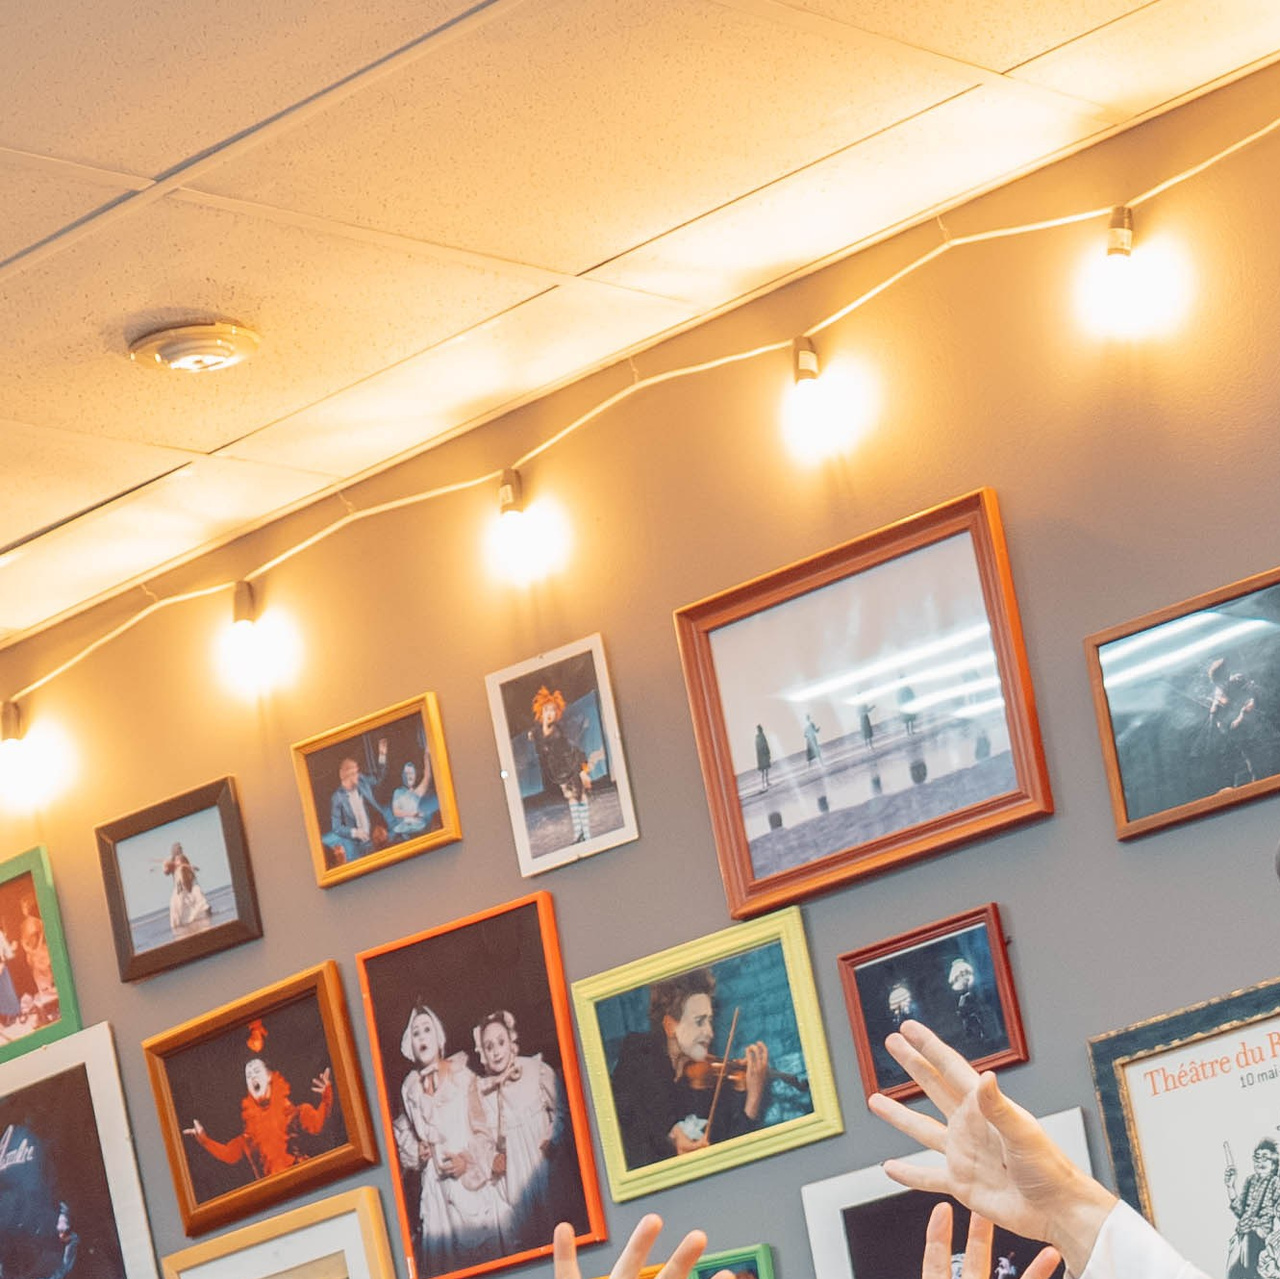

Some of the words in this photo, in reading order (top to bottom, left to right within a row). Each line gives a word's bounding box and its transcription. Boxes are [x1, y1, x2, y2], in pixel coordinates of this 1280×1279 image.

[1144, 1055, 1232, 1097] Théâtre
[1235, 1041, 1265, 1069] du
[1240, 1072, 1255, 1089] 10
